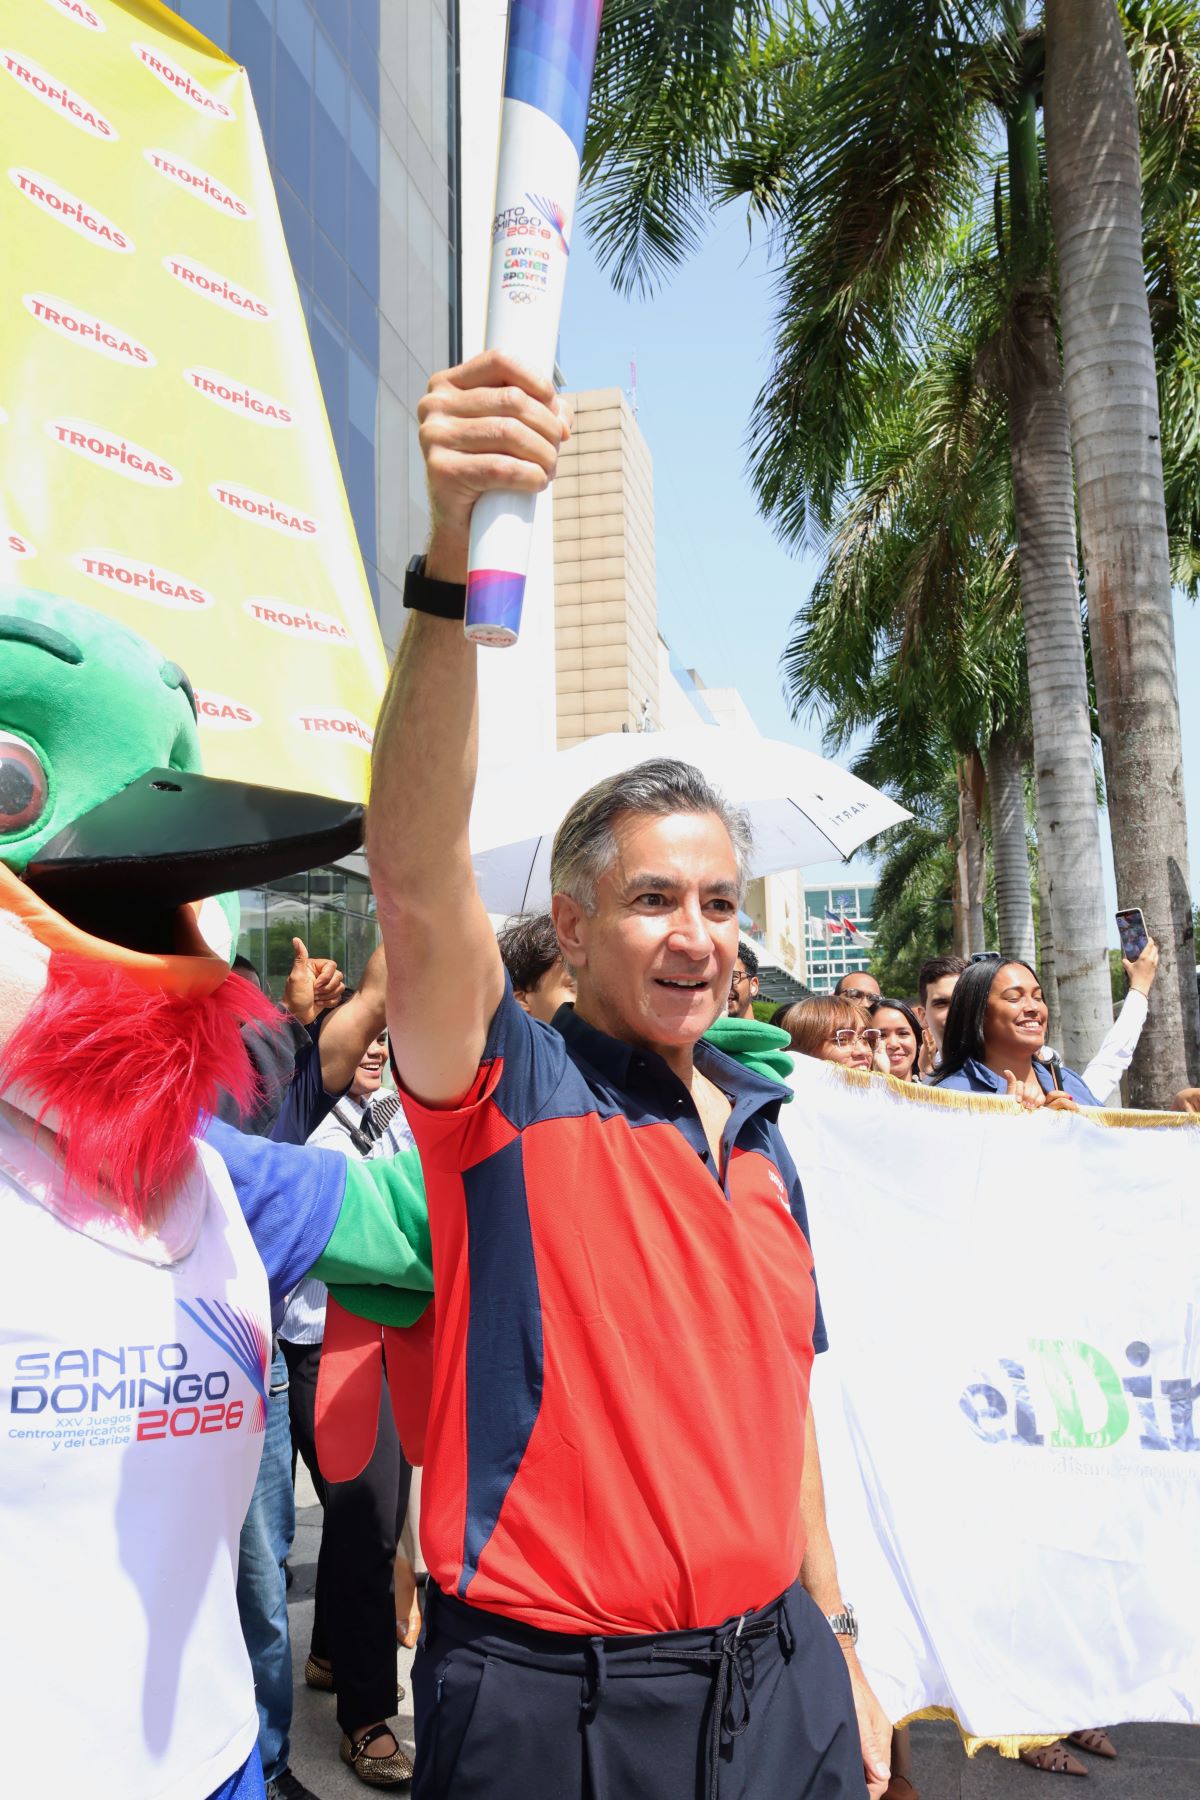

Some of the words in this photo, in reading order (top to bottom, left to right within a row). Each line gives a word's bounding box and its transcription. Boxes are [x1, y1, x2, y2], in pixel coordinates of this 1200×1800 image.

[505, 248, 549, 260] CENTRO
[504, 259, 548, 272] CARIBE
[503, 272, 546, 284] SPORTS
[14, 1342, 188, 1380] SANTO
[10, 1370, 230, 1414] DOMINGO
[55, 1415, 85, 1428] XXV
[86, 1413, 132, 1428] Juegos
[136, 1400, 244, 1441] 2026
[8, 1424, 131, 1439] Centroamericanos
[52, 1440, 61, 1451] y
[64, 1438, 86, 1449] del
[89, 1434, 130, 1447] Caribe
